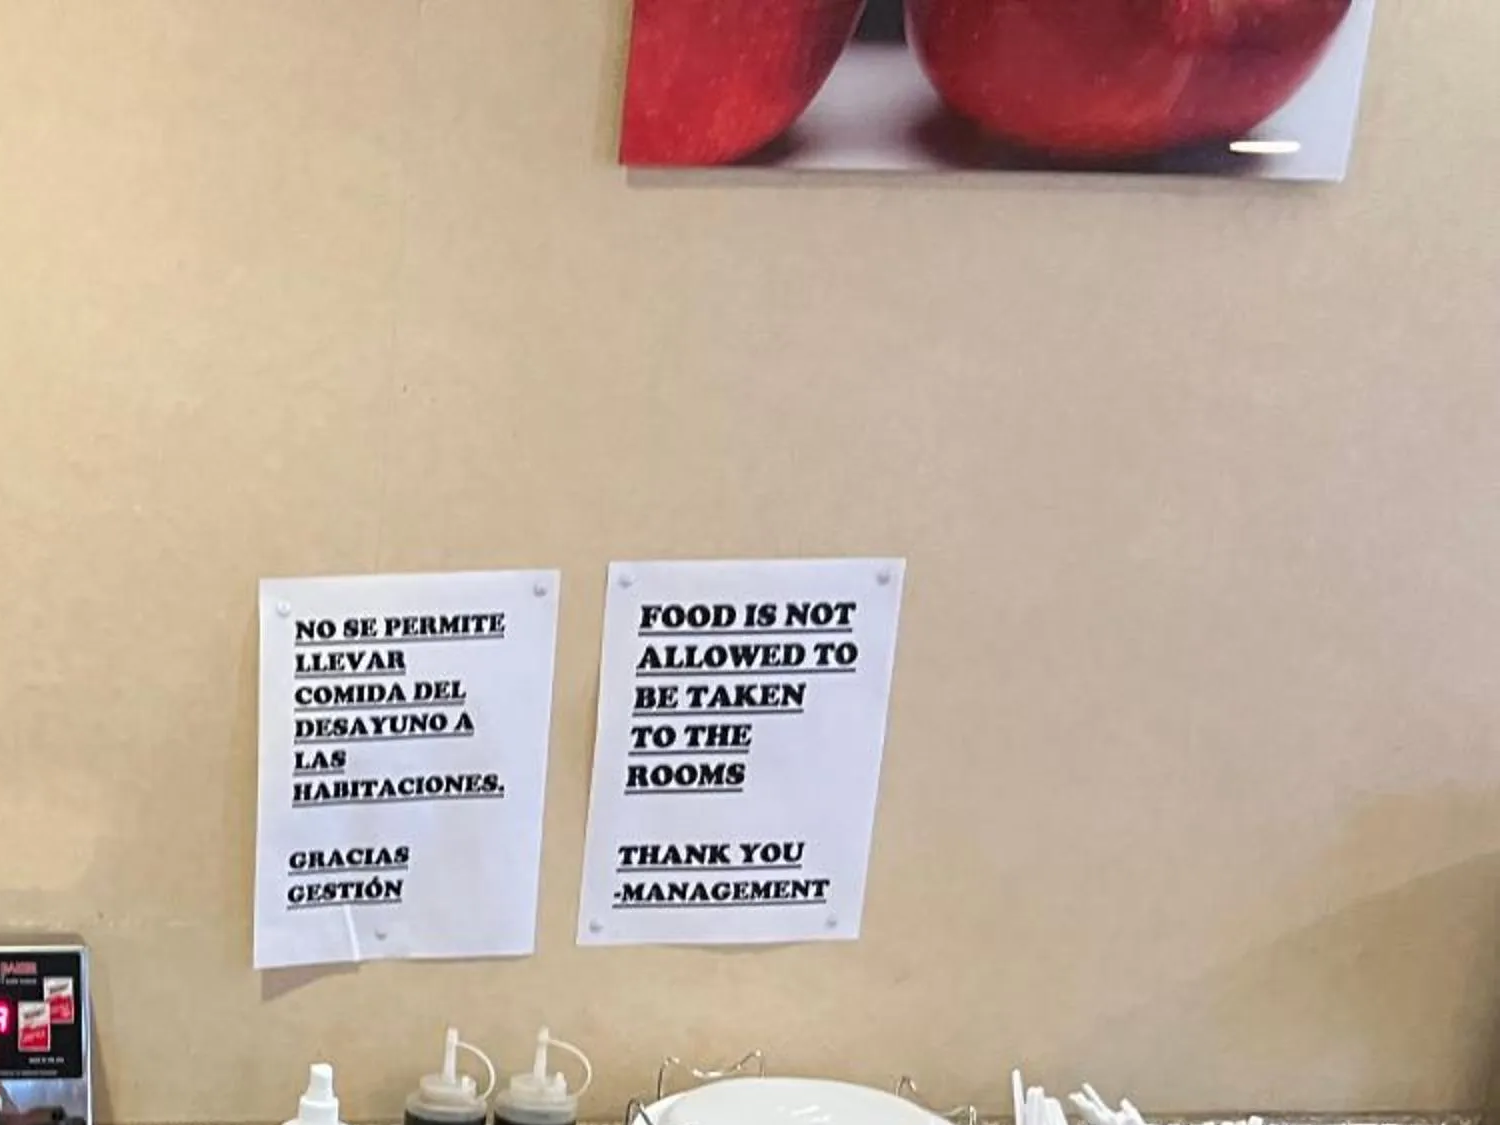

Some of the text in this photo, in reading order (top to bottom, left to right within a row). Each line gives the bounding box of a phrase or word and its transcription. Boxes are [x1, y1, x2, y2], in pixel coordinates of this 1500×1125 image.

[295, 613, 505, 640] NO SE PERMITE
[639, 602, 857, 628] FOOD IS NOT
[295, 650, 405, 673] LLEVAR
[636, 641, 858, 669] ALLOWED TO
[294, 680, 466, 706] COMIDA DEL
[634, 683, 806, 710] BE TAKEN
[294, 713, 474, 738] DESAYUNO A
[631, 724, 752, 748] TO THE
[294, 750, 347, 770] LAS
[293, 774, 505, 802] HABITACIONES.
[626, 763, 746, 788] ROOMS
[289, 846, 410, 870] GRACIAS
[617, 841, 805, 866] THANK YOU
[287, 875, 403, 903] GESTIÓN
[613, 879, 830, 903] -MANAGEMENT
